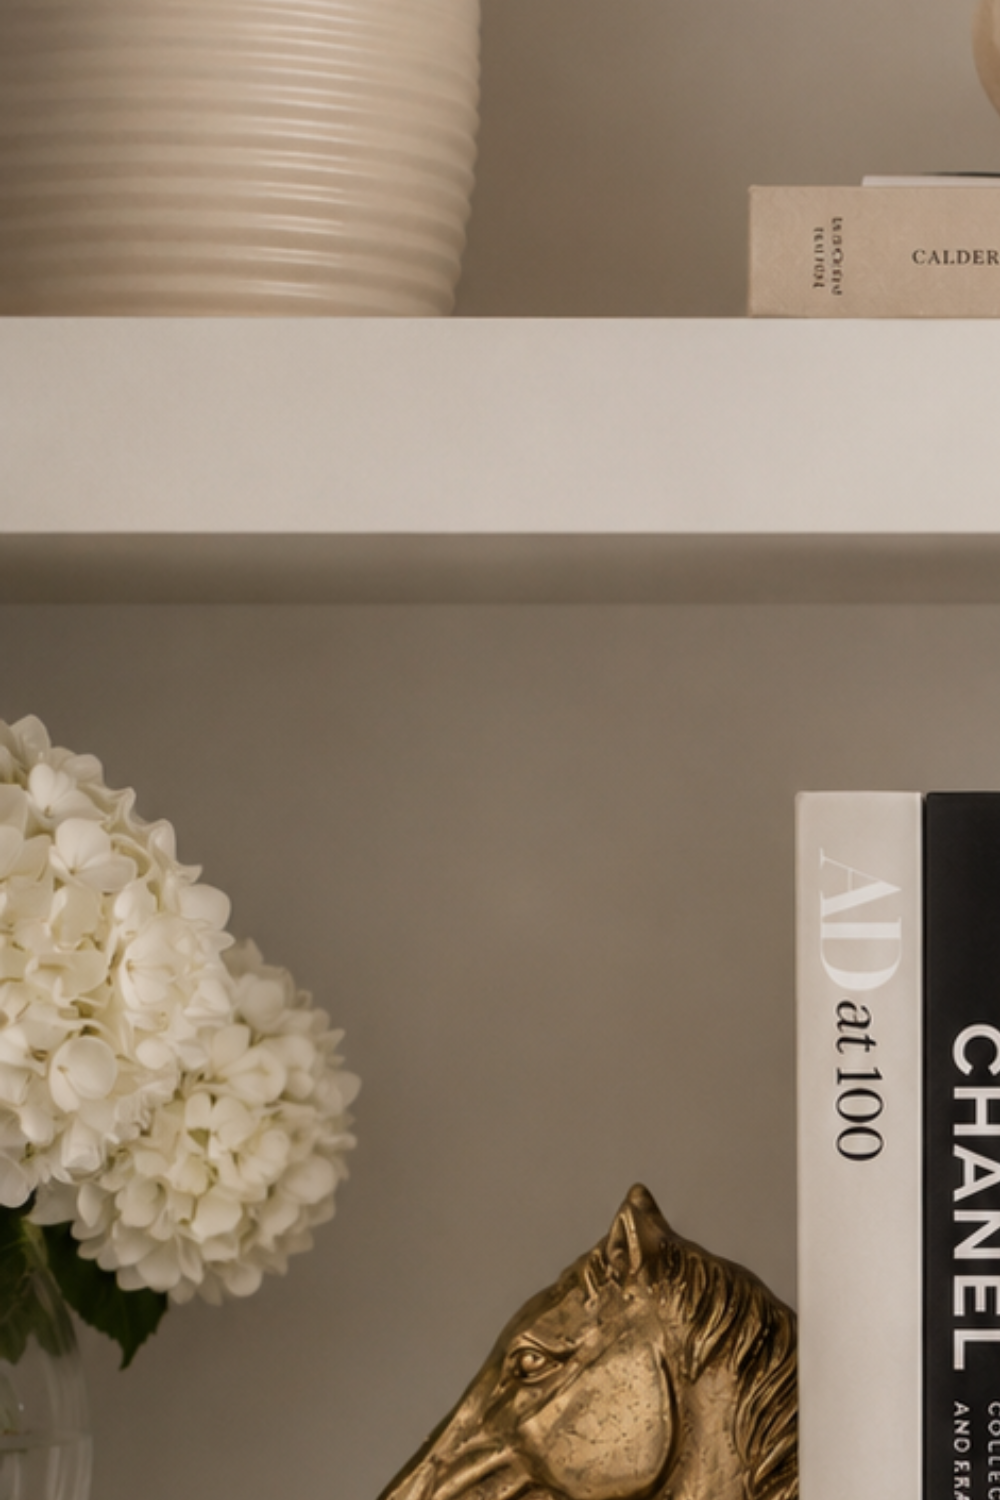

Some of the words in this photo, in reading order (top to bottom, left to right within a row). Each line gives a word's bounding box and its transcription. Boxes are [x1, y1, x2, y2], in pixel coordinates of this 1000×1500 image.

[820, 847, 902, 992] AD
[835, 1000, 877, 1054] at
[836, 1067, 884, 1162] 100
[953, 1401, 971, 1453] AND
